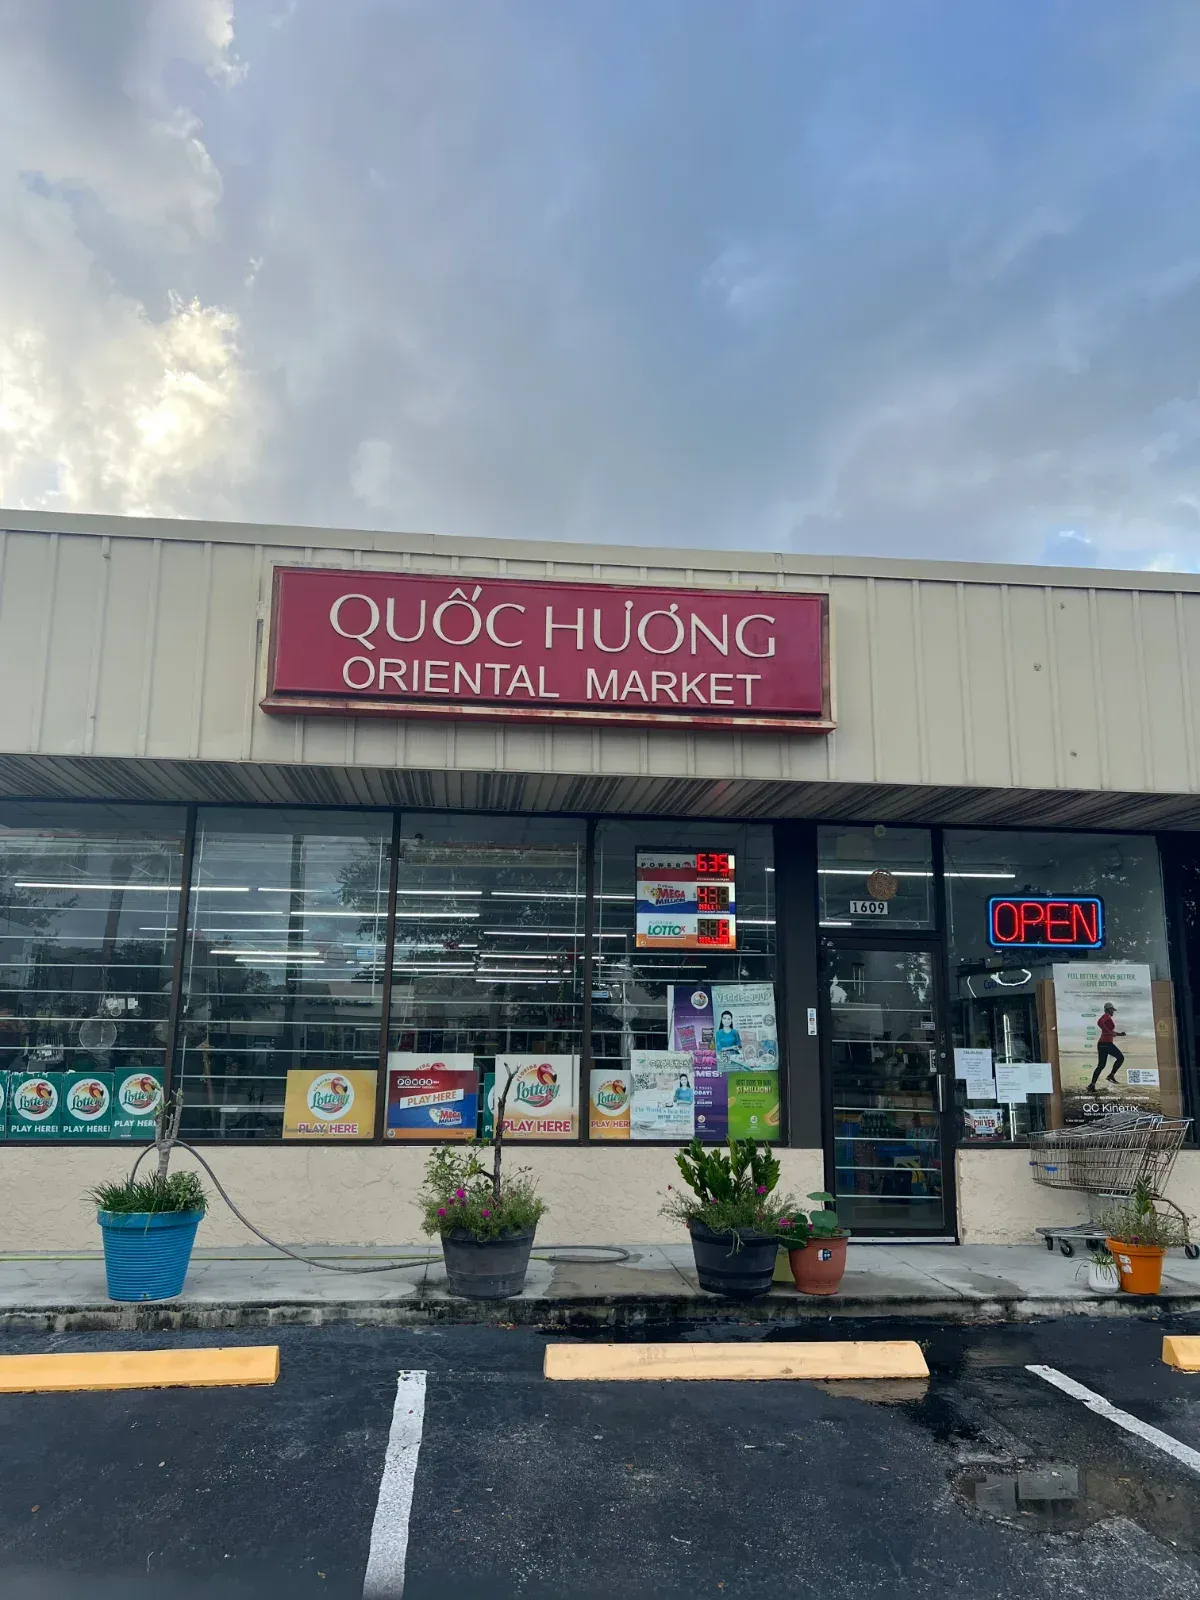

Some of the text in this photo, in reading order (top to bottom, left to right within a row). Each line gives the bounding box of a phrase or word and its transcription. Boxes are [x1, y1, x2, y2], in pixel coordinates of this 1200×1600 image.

[329, 585, 775, 657] QUỐC HƯƠNG
[342, 656, 762, 706] ORIENTAL MARKET
[697, 853, 729, 873] 635
[658, 888, 685, 899] MEGA
[853, 902, 885, 913] 1609
[994, 902, 1097, 943] OPEN
[514, 1081, 560, 1103] Lottery
[310, 1091, 350, 1111] Lottery
[407, 1091, 457, 1106] PLAY HERE
[1082, 1103, 1100, 1113] QC
[440, 1110, 461, 1118] MEGA
[11, 1125, 31, 1133] PLAY
[34, 1125, 58, 1133] HERE!
[63, 1125, 111, 1133] PLAY HERE!
[298, 1124, 358, 1134] PLAY HERE
[501, 1121, 571, 1132] PLAY HERE
